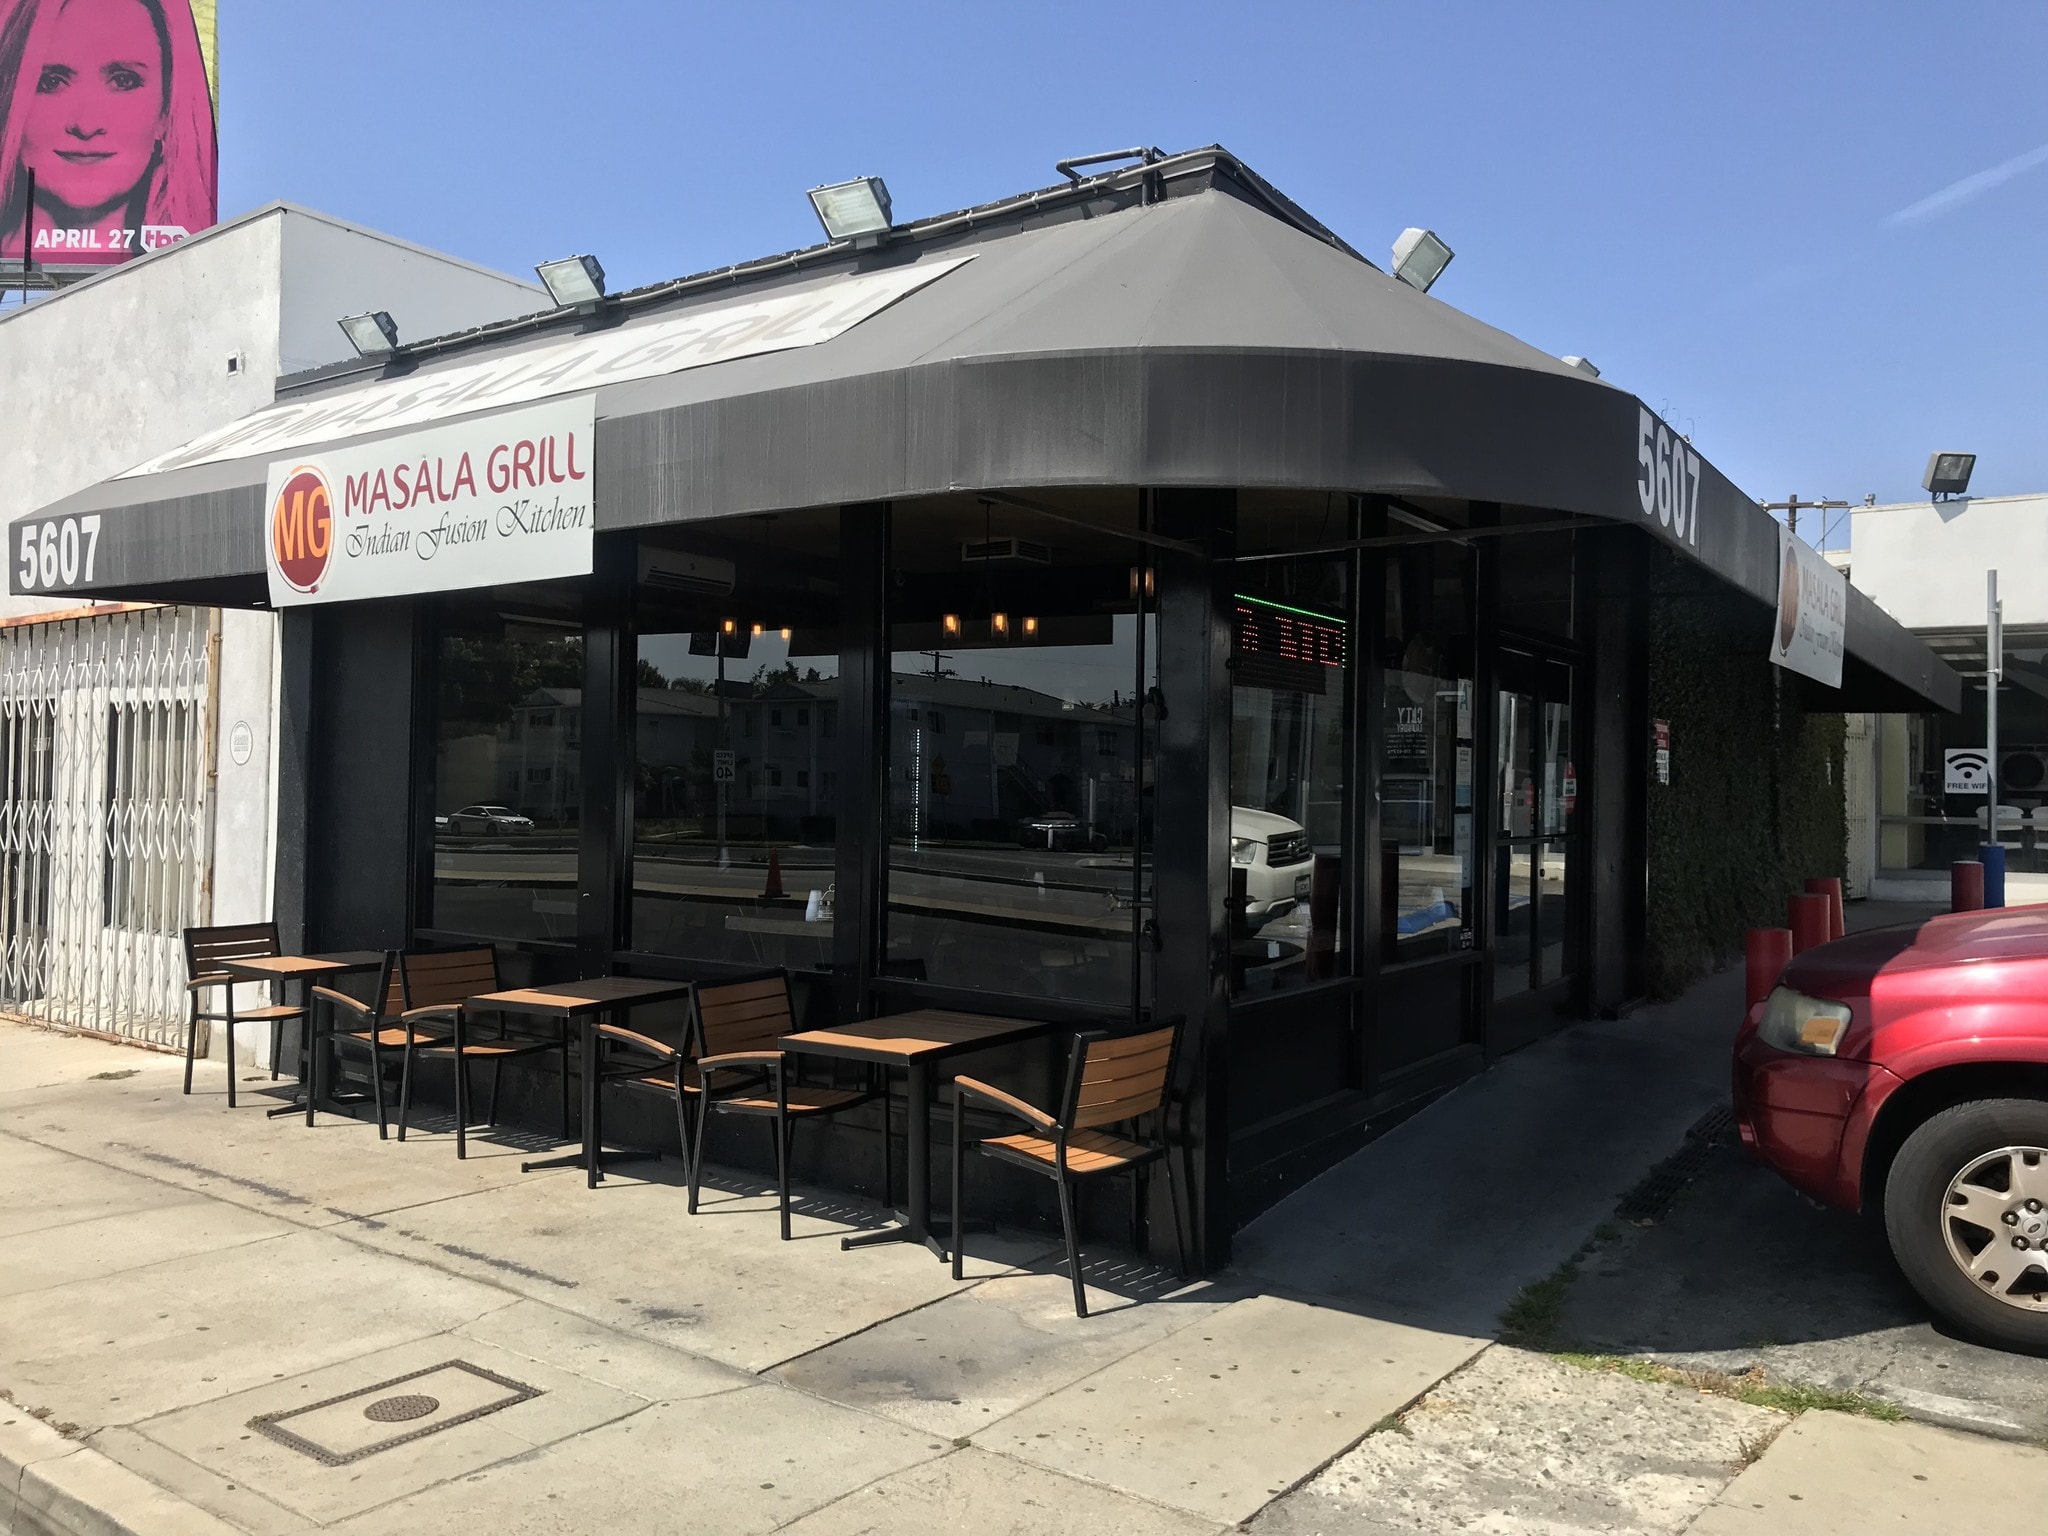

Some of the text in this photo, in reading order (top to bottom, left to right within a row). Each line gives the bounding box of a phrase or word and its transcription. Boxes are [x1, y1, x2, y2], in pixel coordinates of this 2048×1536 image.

[34, 229, 136, 248] APRIL 27
[344, 431, 587, 517] MASALA GRILL
[1638, 406, 1701, 546] 5607
[19, 514, 101, 589] 5607
[273, 485, 332, 562] MG
[344, 495, 587, 561] Indian Fusion Kitchen
[1947, 782, 1988, 790] FREE WIF
